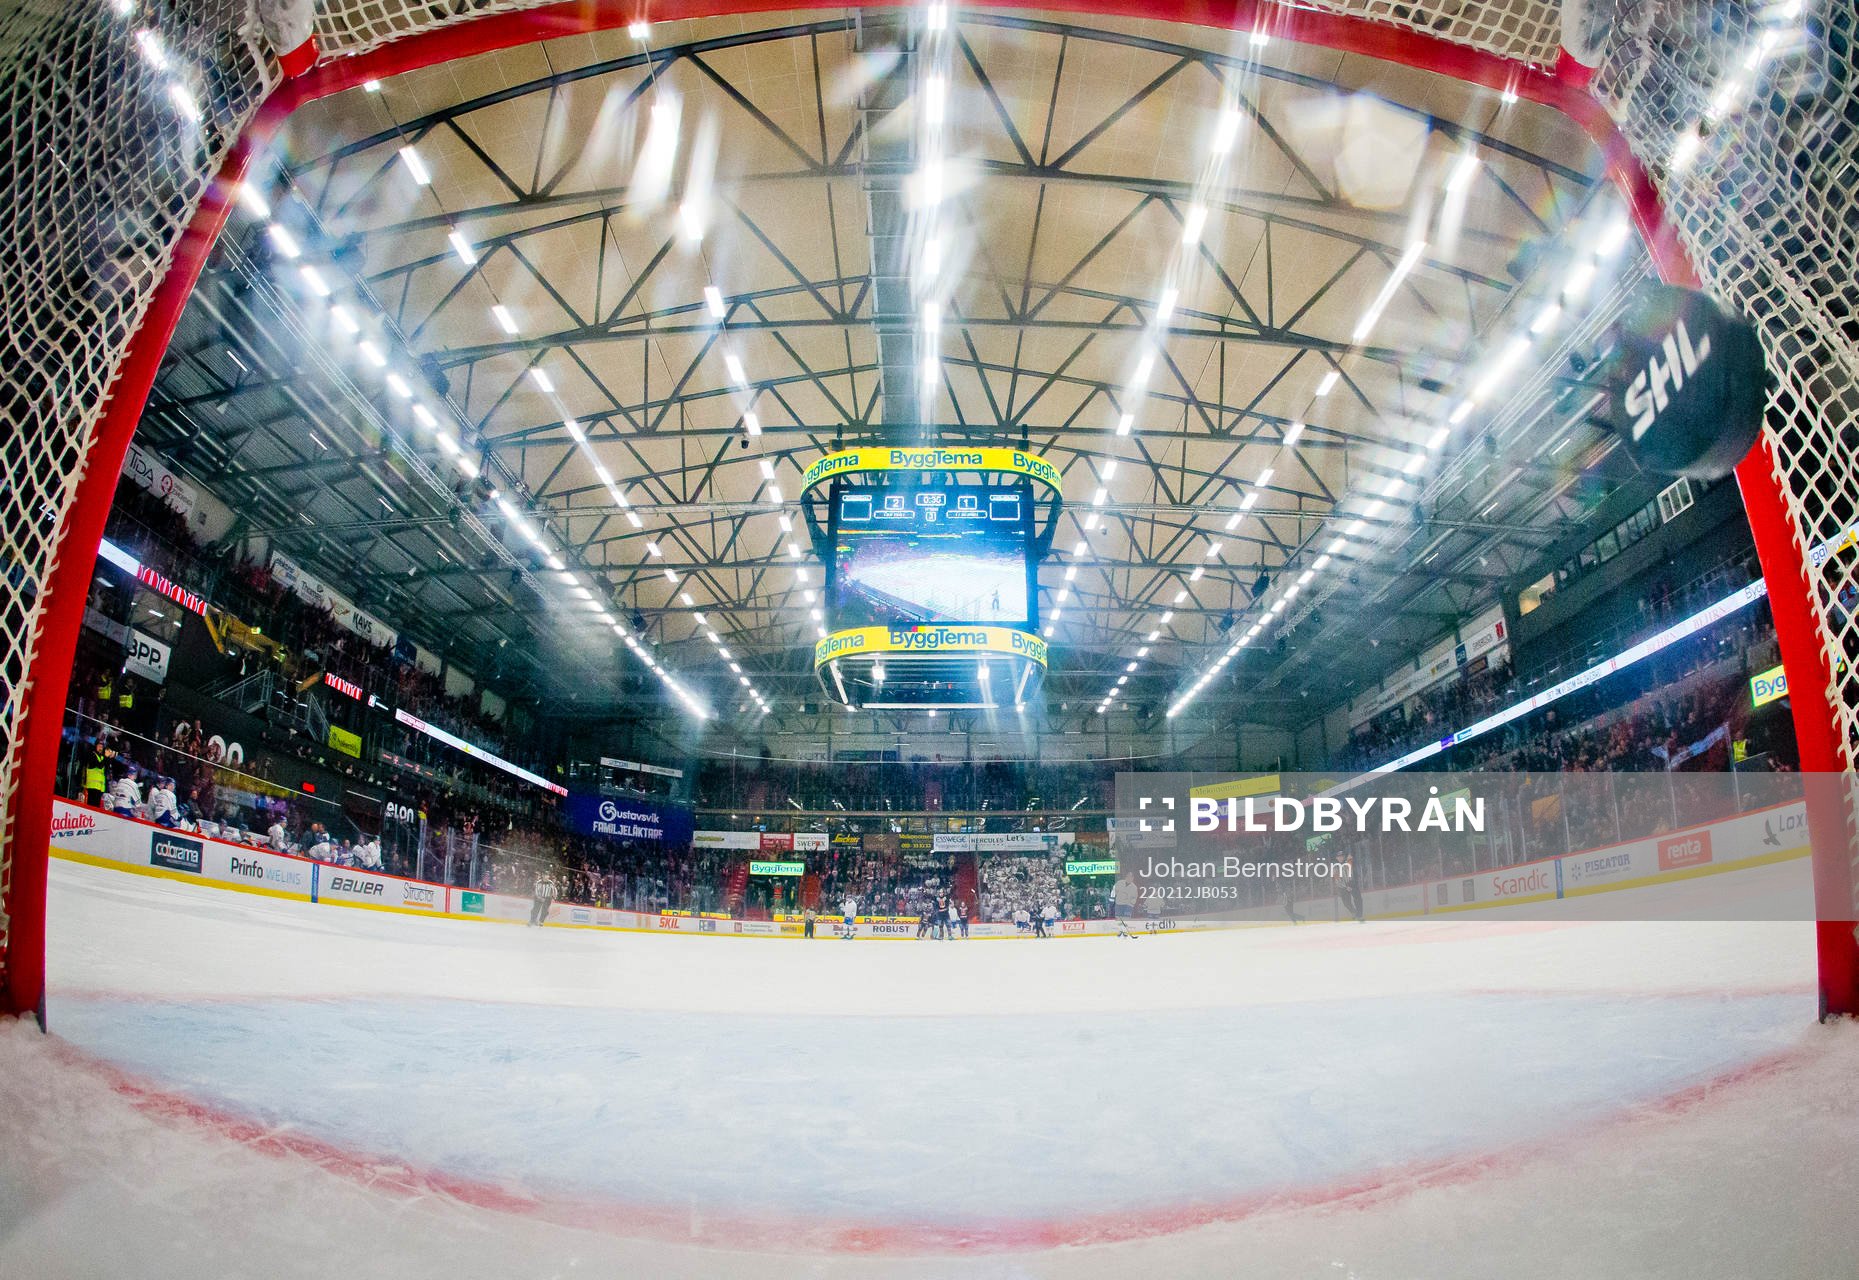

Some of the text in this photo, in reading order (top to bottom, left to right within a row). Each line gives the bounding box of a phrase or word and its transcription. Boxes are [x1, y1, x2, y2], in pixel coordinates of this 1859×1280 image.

[1624, 320, 1711, 441] SHL
[890, 450, 983, 468] ByggTema
[892, 499, 899, 508] 2
[963, 499, 969, 508] 1
[890, 628, 987, 648] ByggTema
[51, 811, 95, 831] adiator
[599, 800, 660, 823] Gustavsvik
[155, 841, 199, 864] colorama
[1667, 839, 1702, 860] renta
[230, 856, 264, 879] Prinfo
[751, 863, 803, 875] ByggTema
[1067, 863, 1120, 873] ByggTema
[1585, 853, 1631, 873] PISCATOR
[1493, 868, 1549, 897] Scandic
[659, 917, 680, 929] SKIL
[872, 925, 911, 933] ROBUST
